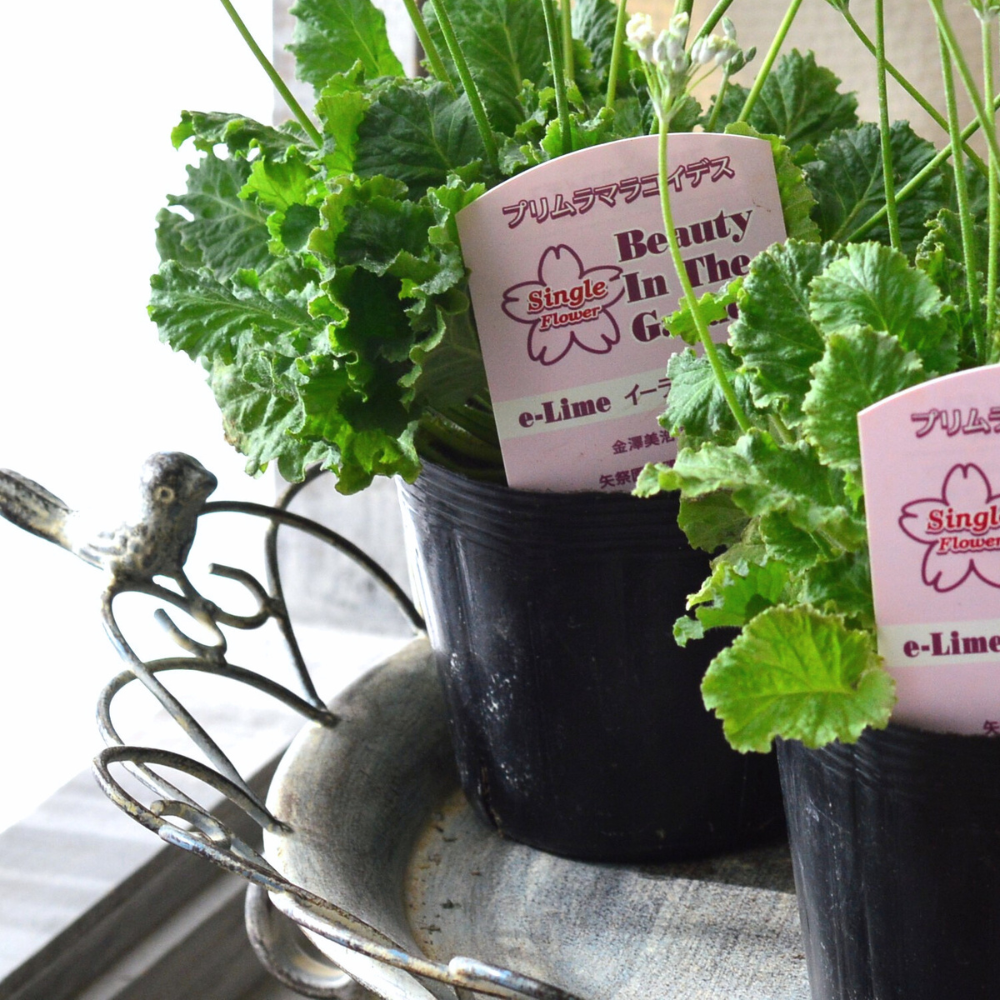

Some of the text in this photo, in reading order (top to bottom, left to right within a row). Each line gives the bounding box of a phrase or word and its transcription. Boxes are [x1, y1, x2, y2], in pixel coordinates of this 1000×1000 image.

[502, 155, 735, 229] プリムラマラコイデス
[614, 210, 753, 262] Beauty
[527, 278, 608, 313] Single
[622, 252, 750, 303] In The
[540, 306, 602, 331] Flower
[518, 396, 611, 428] e-Lime
